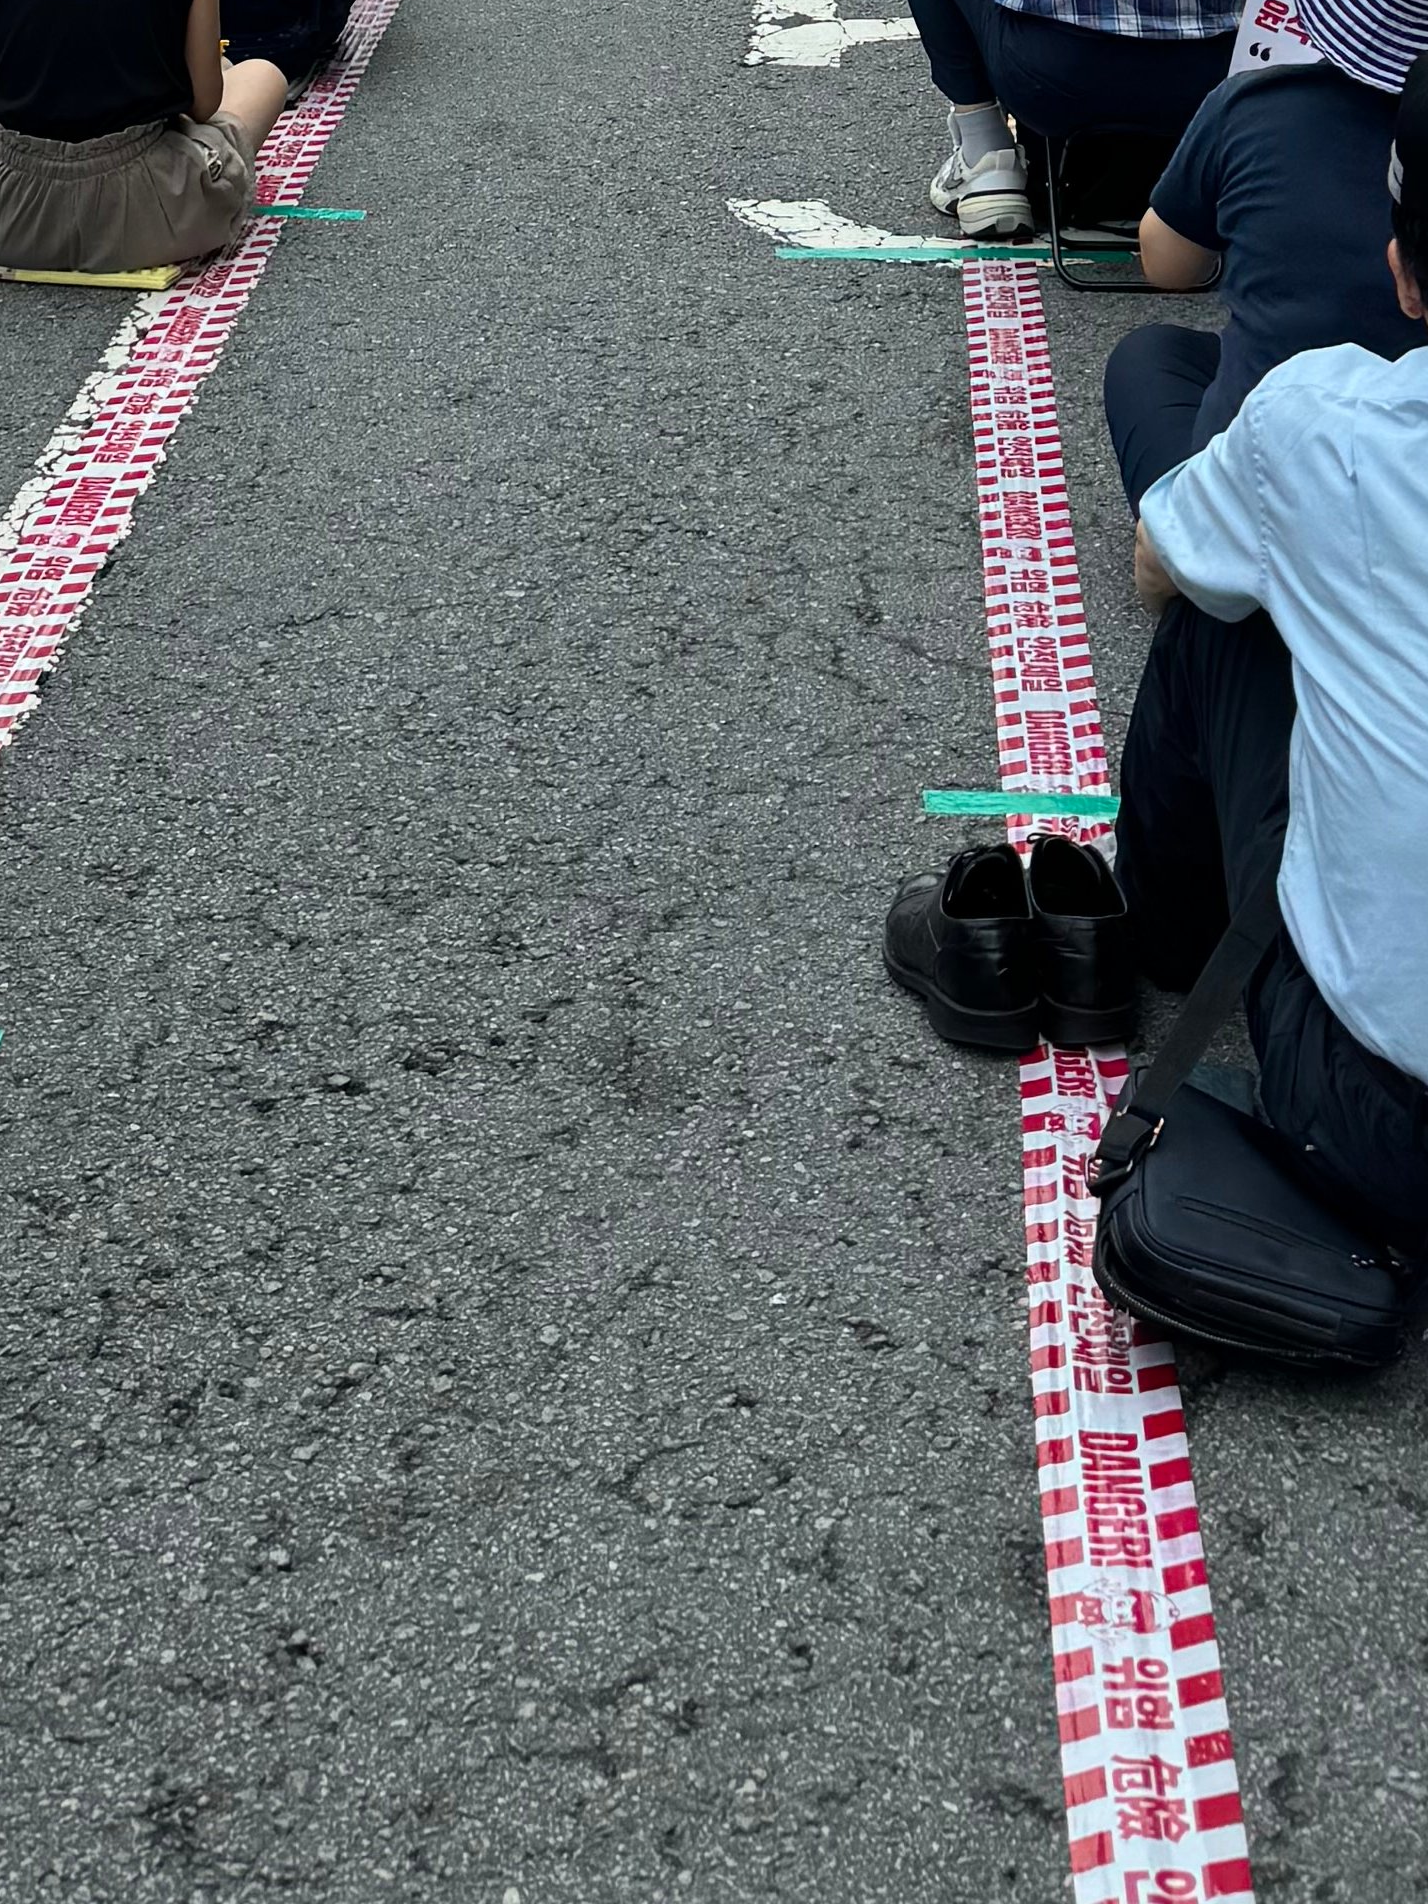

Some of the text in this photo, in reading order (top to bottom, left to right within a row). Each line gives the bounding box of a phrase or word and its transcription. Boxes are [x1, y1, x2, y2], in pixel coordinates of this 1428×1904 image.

[56, 476, 116, 528] DANGER!
[1002, 489, 1042, 542] DANGER!
[1015, 636, 1063, 694] 안전제일
[1024, 709, 1075, 777] DANGER!
[1077, 1429, 1152, 1569] DANGER!
[1101, 1655, 1176, 1731] 위험
